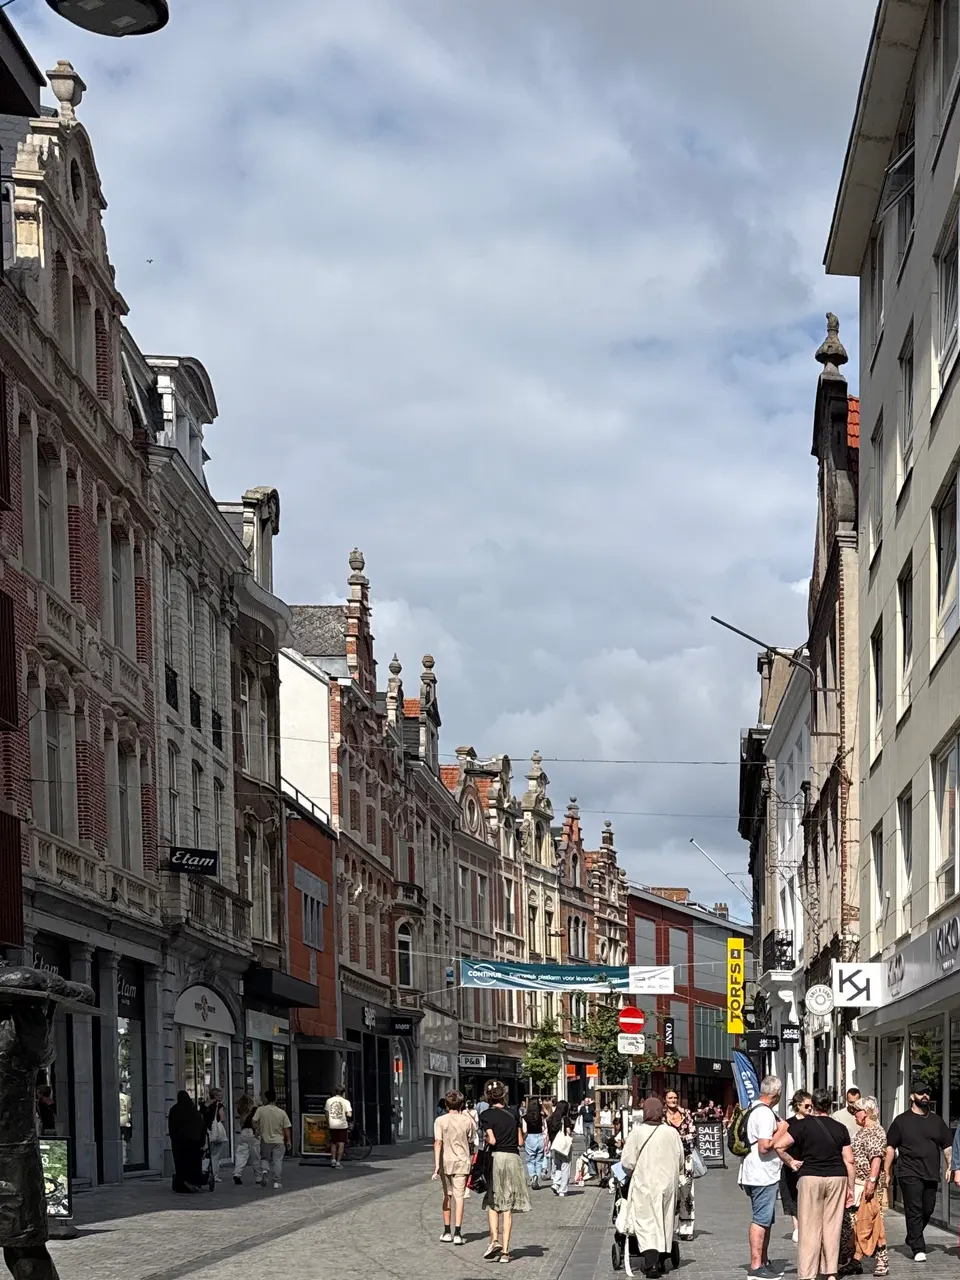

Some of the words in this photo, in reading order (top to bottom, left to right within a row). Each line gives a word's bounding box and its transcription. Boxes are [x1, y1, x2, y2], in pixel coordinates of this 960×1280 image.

[171, 850, 215, 867] Etam
[935, 916, 960, 961] KIKO
[33, 951, 60, 975] Etam
[116, 974, 137, 998] Etam
[730, 962, 742, 1023] TORFS
[665, 1023, 673, 1045] INNO
[464, 1057, 480, 1065] P&B
[698, 1126, 720, 1134] SALE
[698, 1134, 720, 1142] SALE
[699, 1149, 721, 1157] SALE
